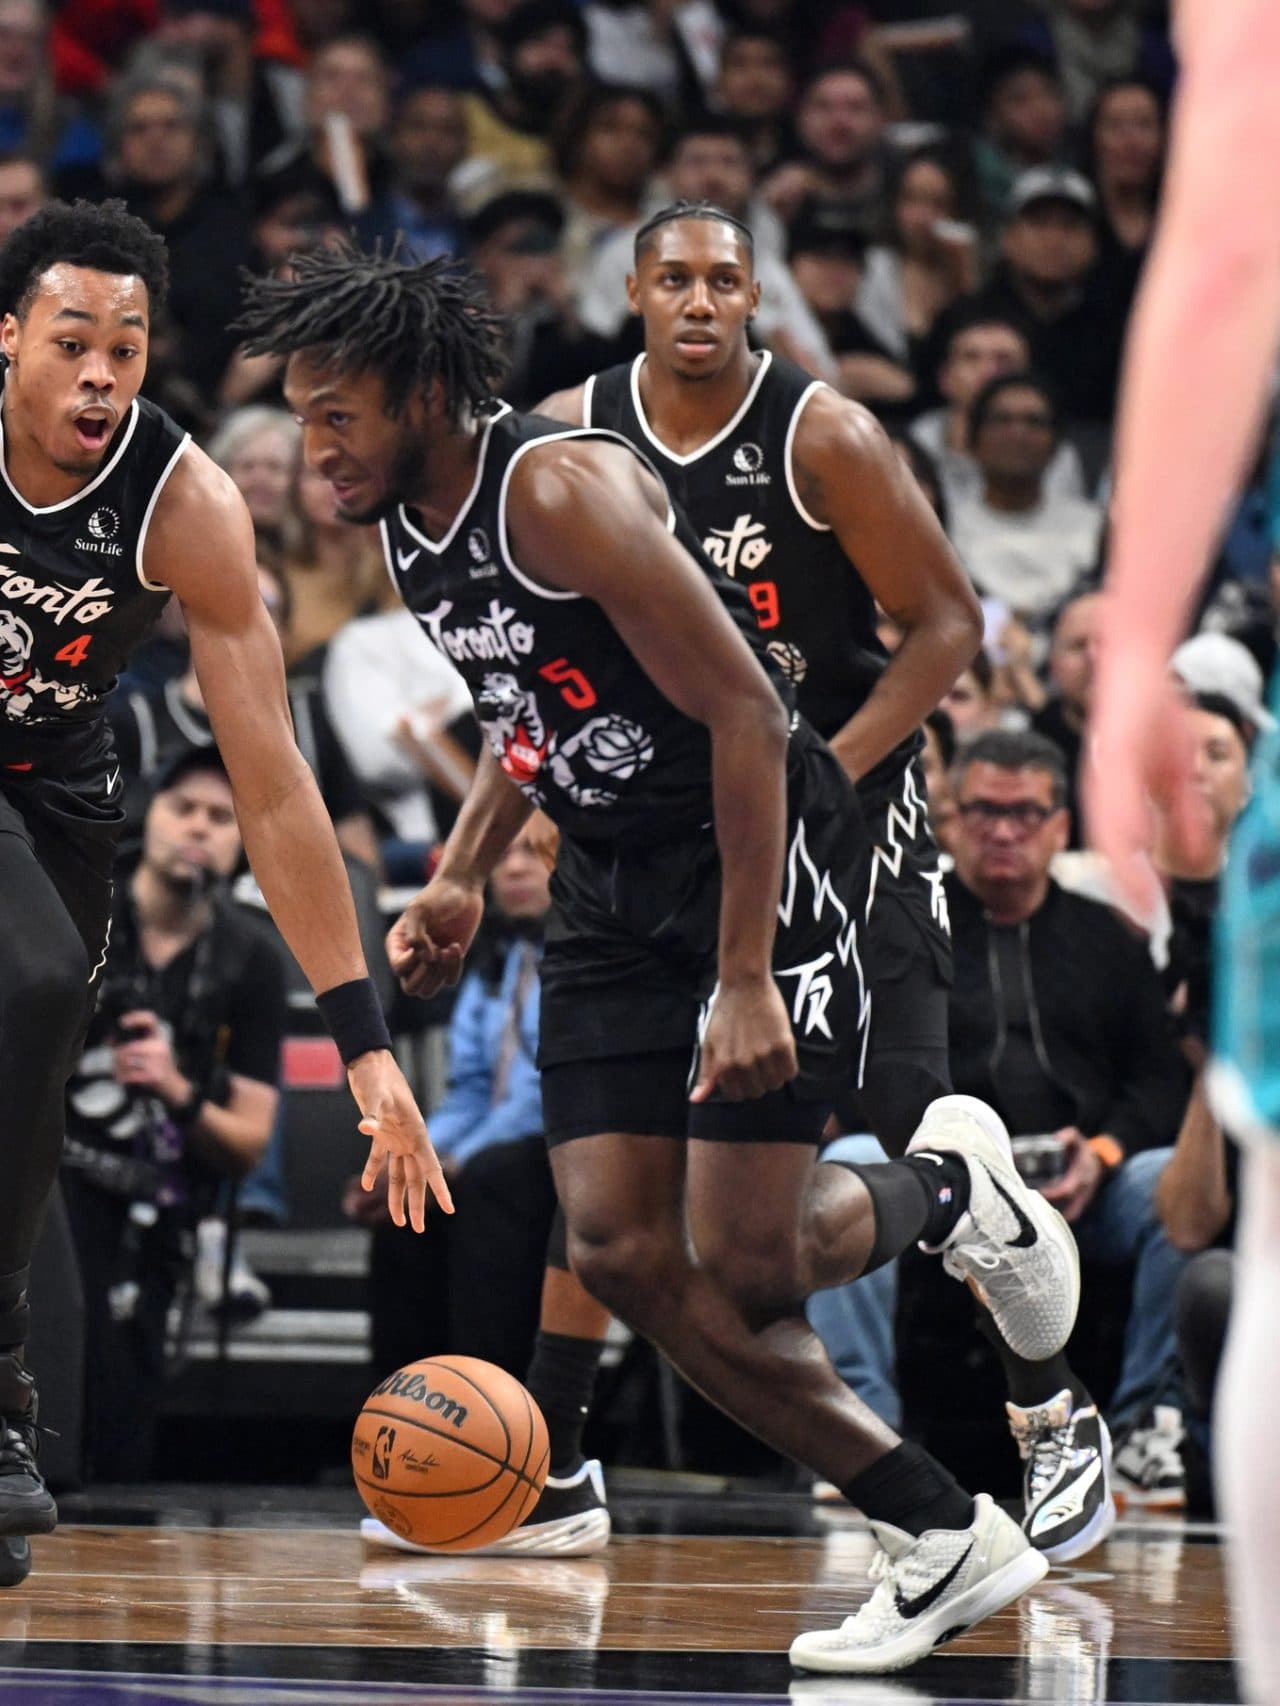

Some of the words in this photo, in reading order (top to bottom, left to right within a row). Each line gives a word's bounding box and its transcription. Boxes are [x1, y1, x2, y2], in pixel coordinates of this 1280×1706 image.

[74, 537, 99, 552] Sun
[100, 541, 123, 557] Life
[748, 581, 780, 630] 9
[54, 633, 93, 668] 4
[416, 599, 535, 666] Toronto
[538, 657, 597, 710] 5
